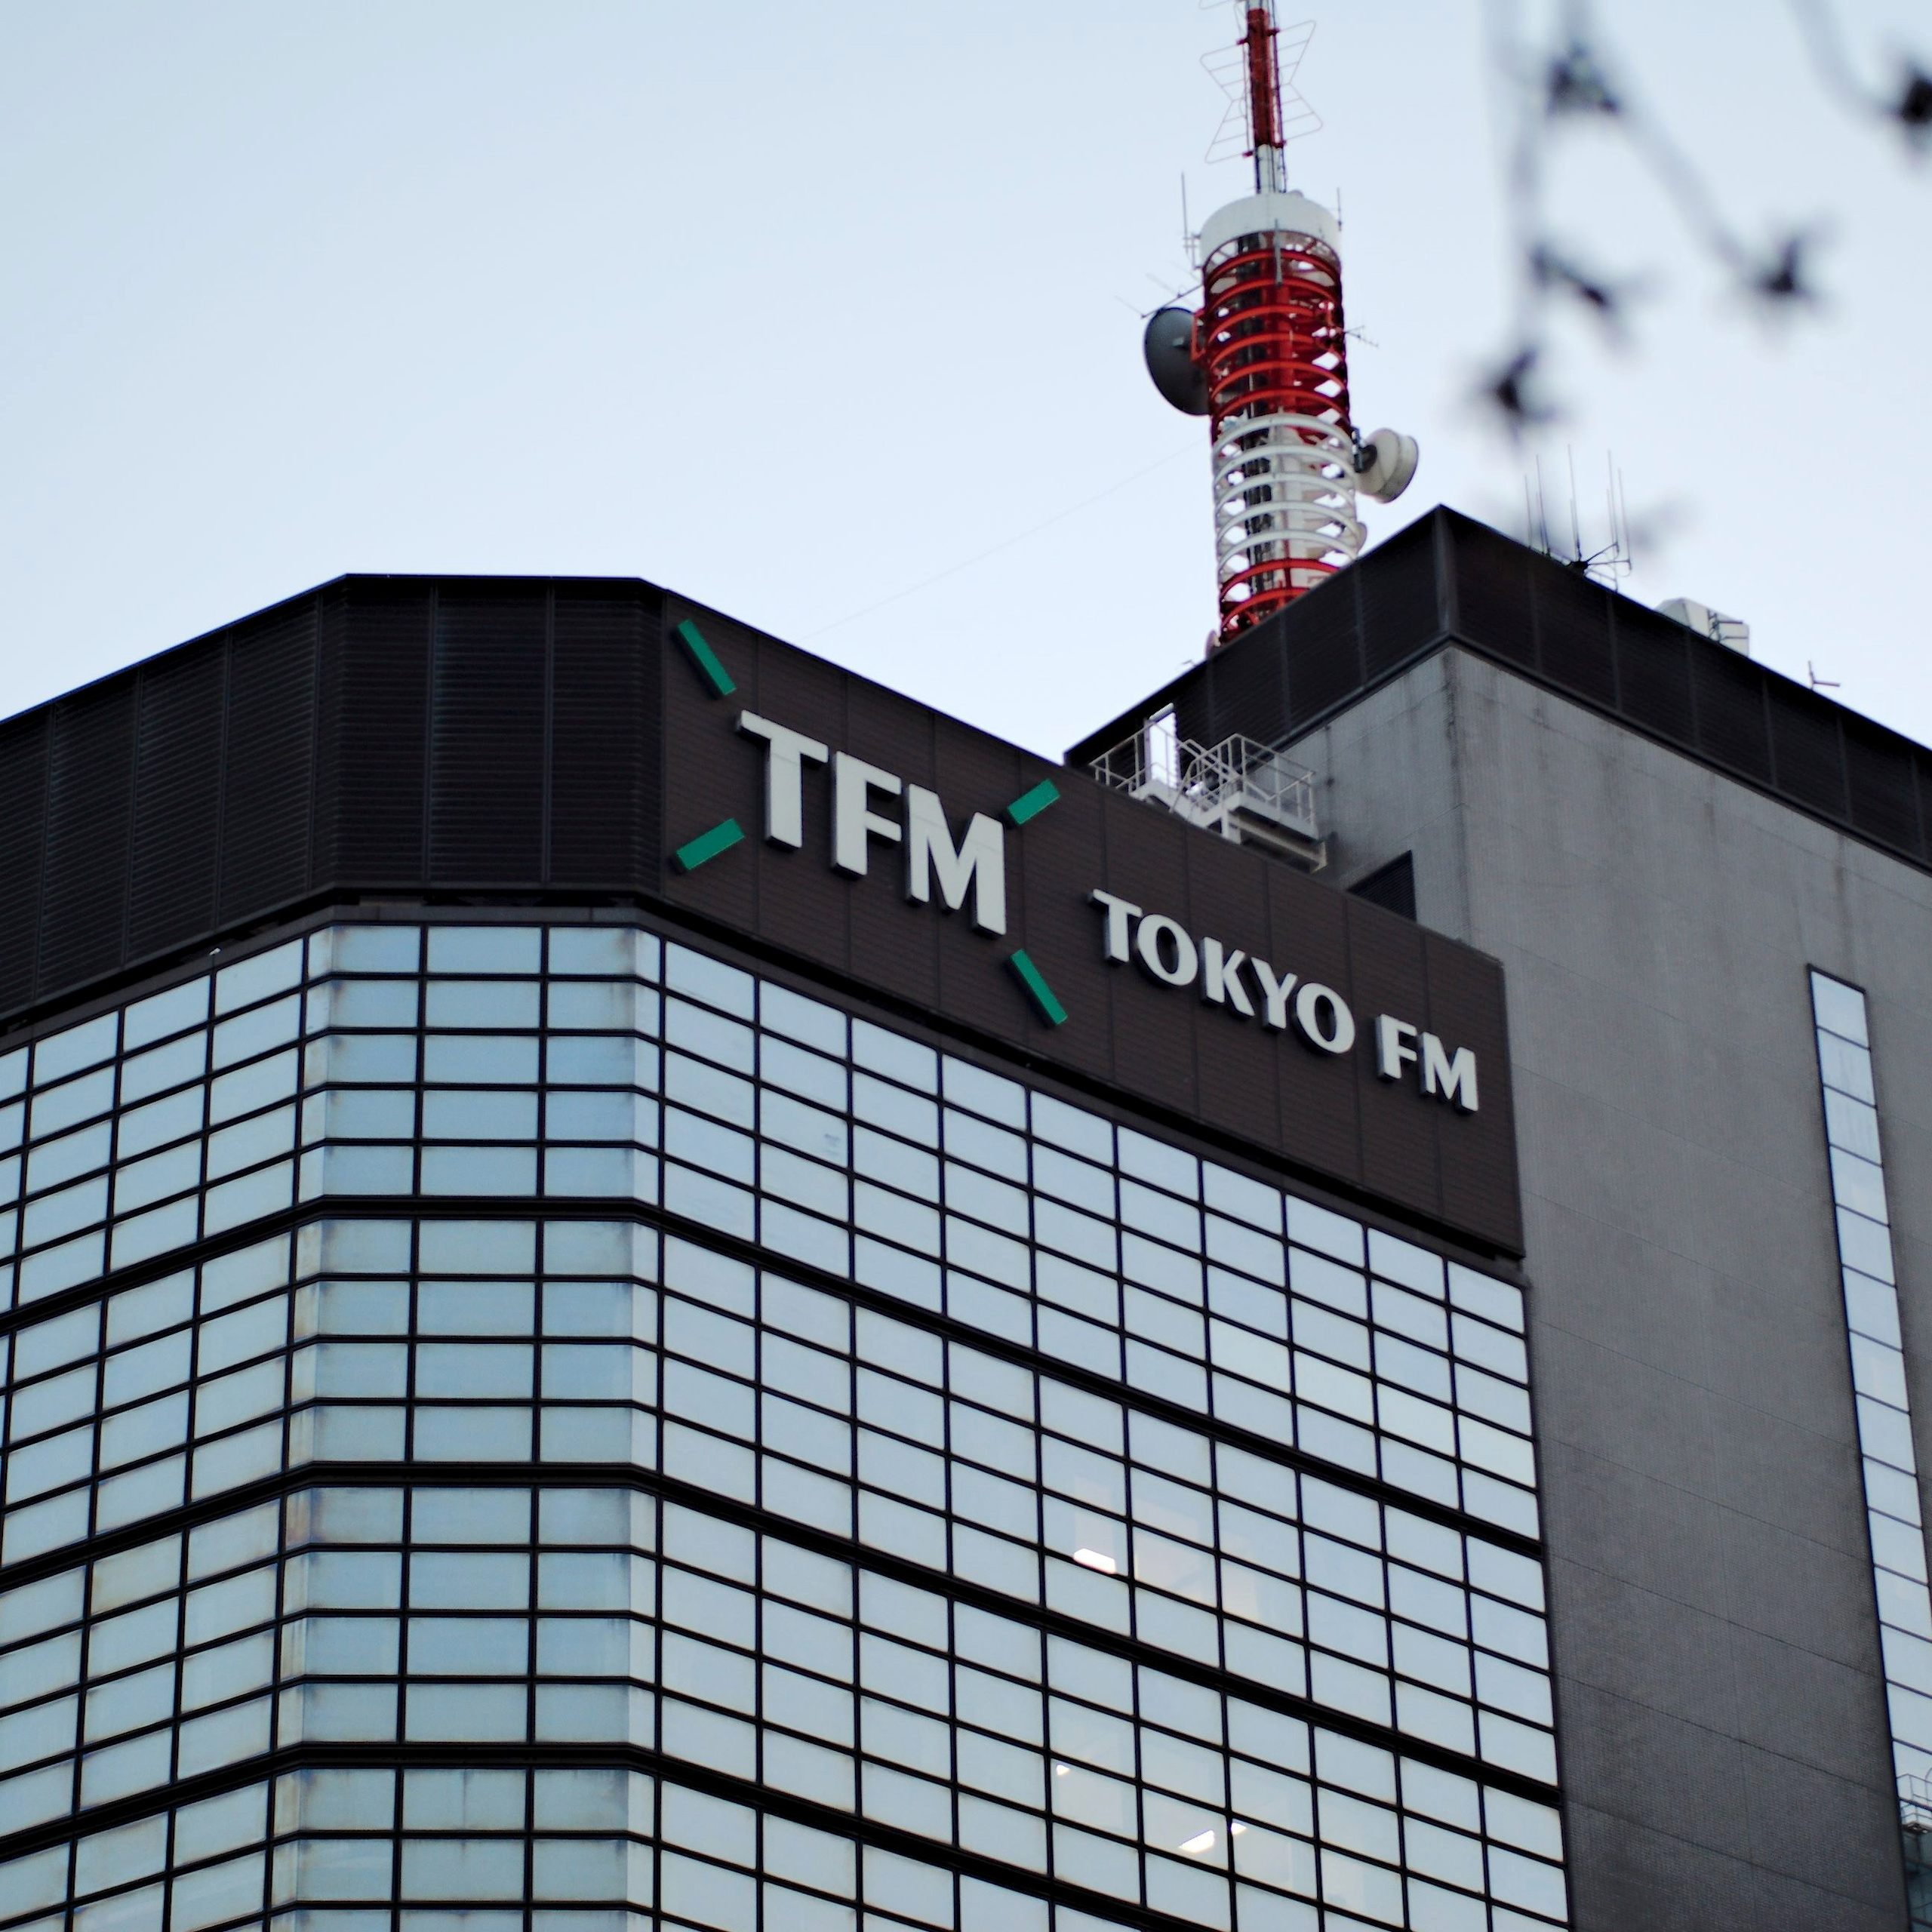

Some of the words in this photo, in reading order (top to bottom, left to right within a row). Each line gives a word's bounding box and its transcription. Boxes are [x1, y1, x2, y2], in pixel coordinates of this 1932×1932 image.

[737, 709, 1008, 936] TFM
[1091, 888, 1356, 1054] TOKYO
[1378, 1014, 1479, 1113] FM
